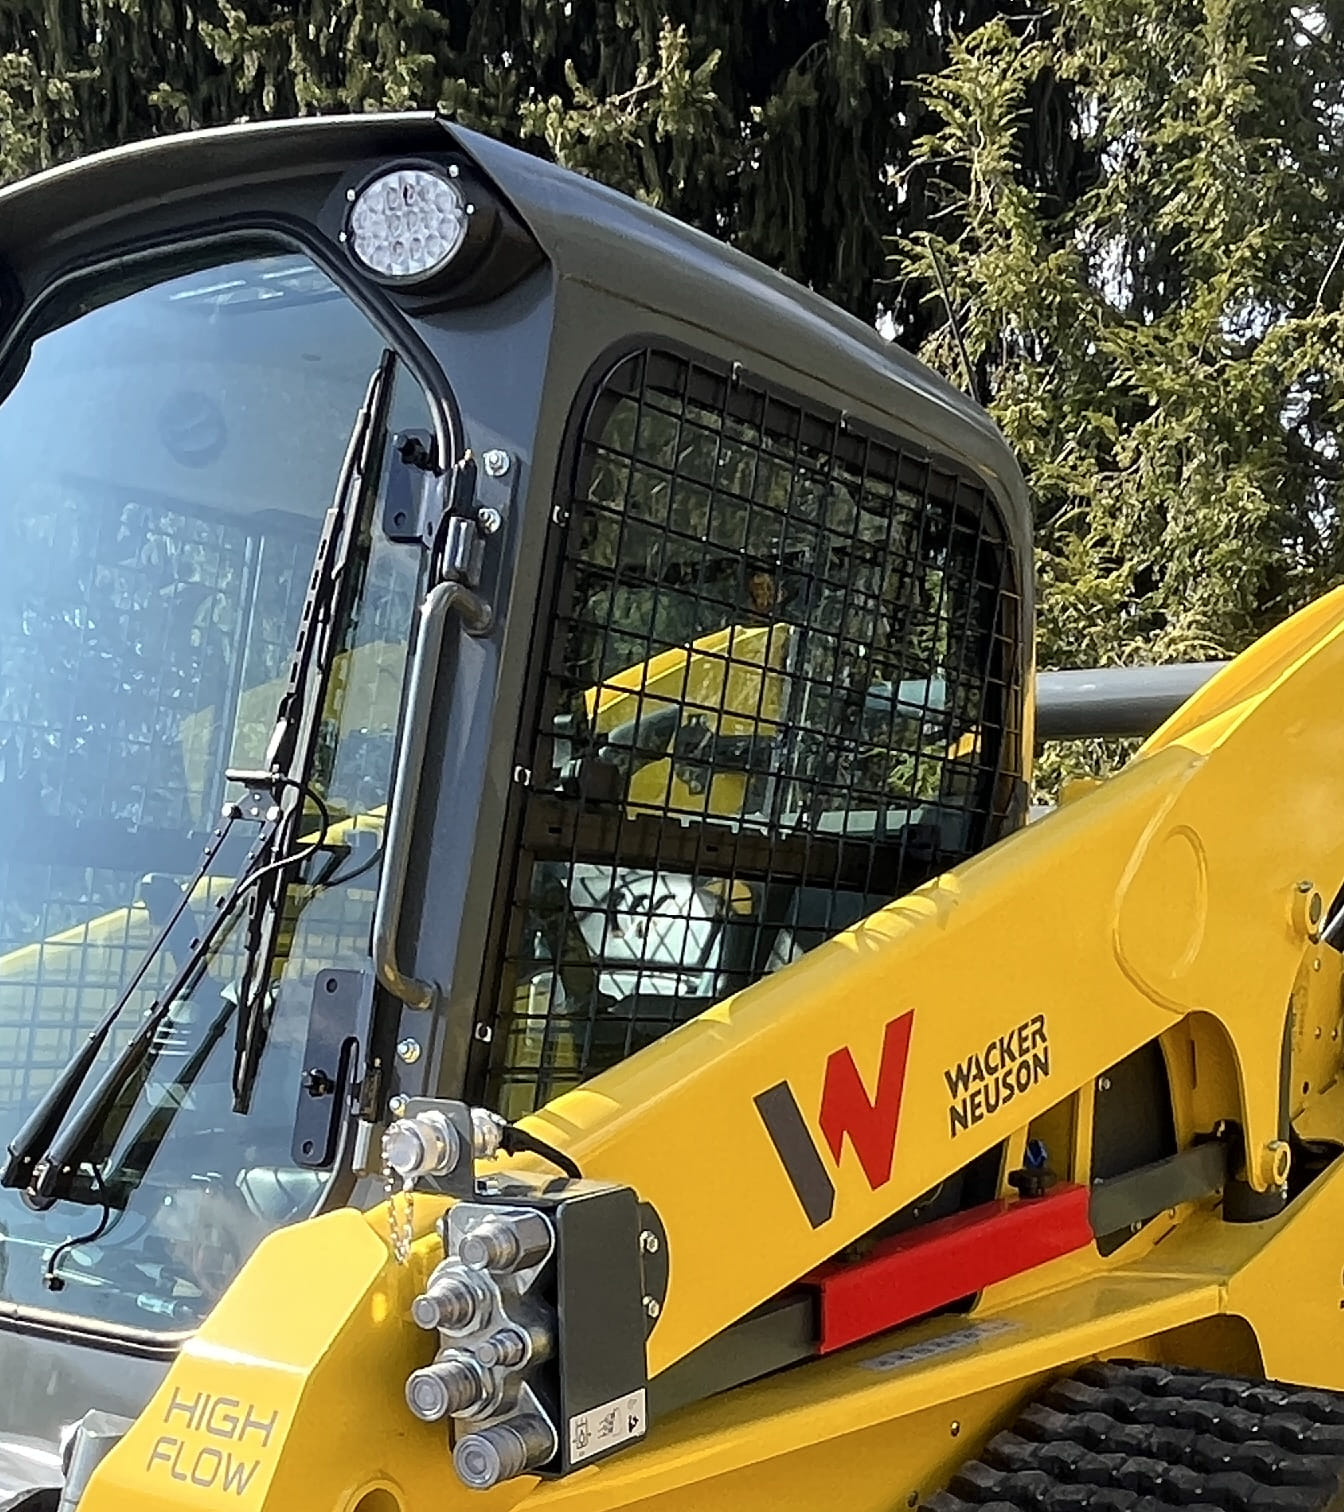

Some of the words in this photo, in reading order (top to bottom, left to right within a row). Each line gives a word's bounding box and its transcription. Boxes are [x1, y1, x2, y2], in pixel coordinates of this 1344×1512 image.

[944, 1014, 1047, 1100] WACKER
[949, 1045, 1050, 1138] NEUSON
[163, 1386, 279, 1448] HIGH
[146, 1436, 261, 1496] FLOW
